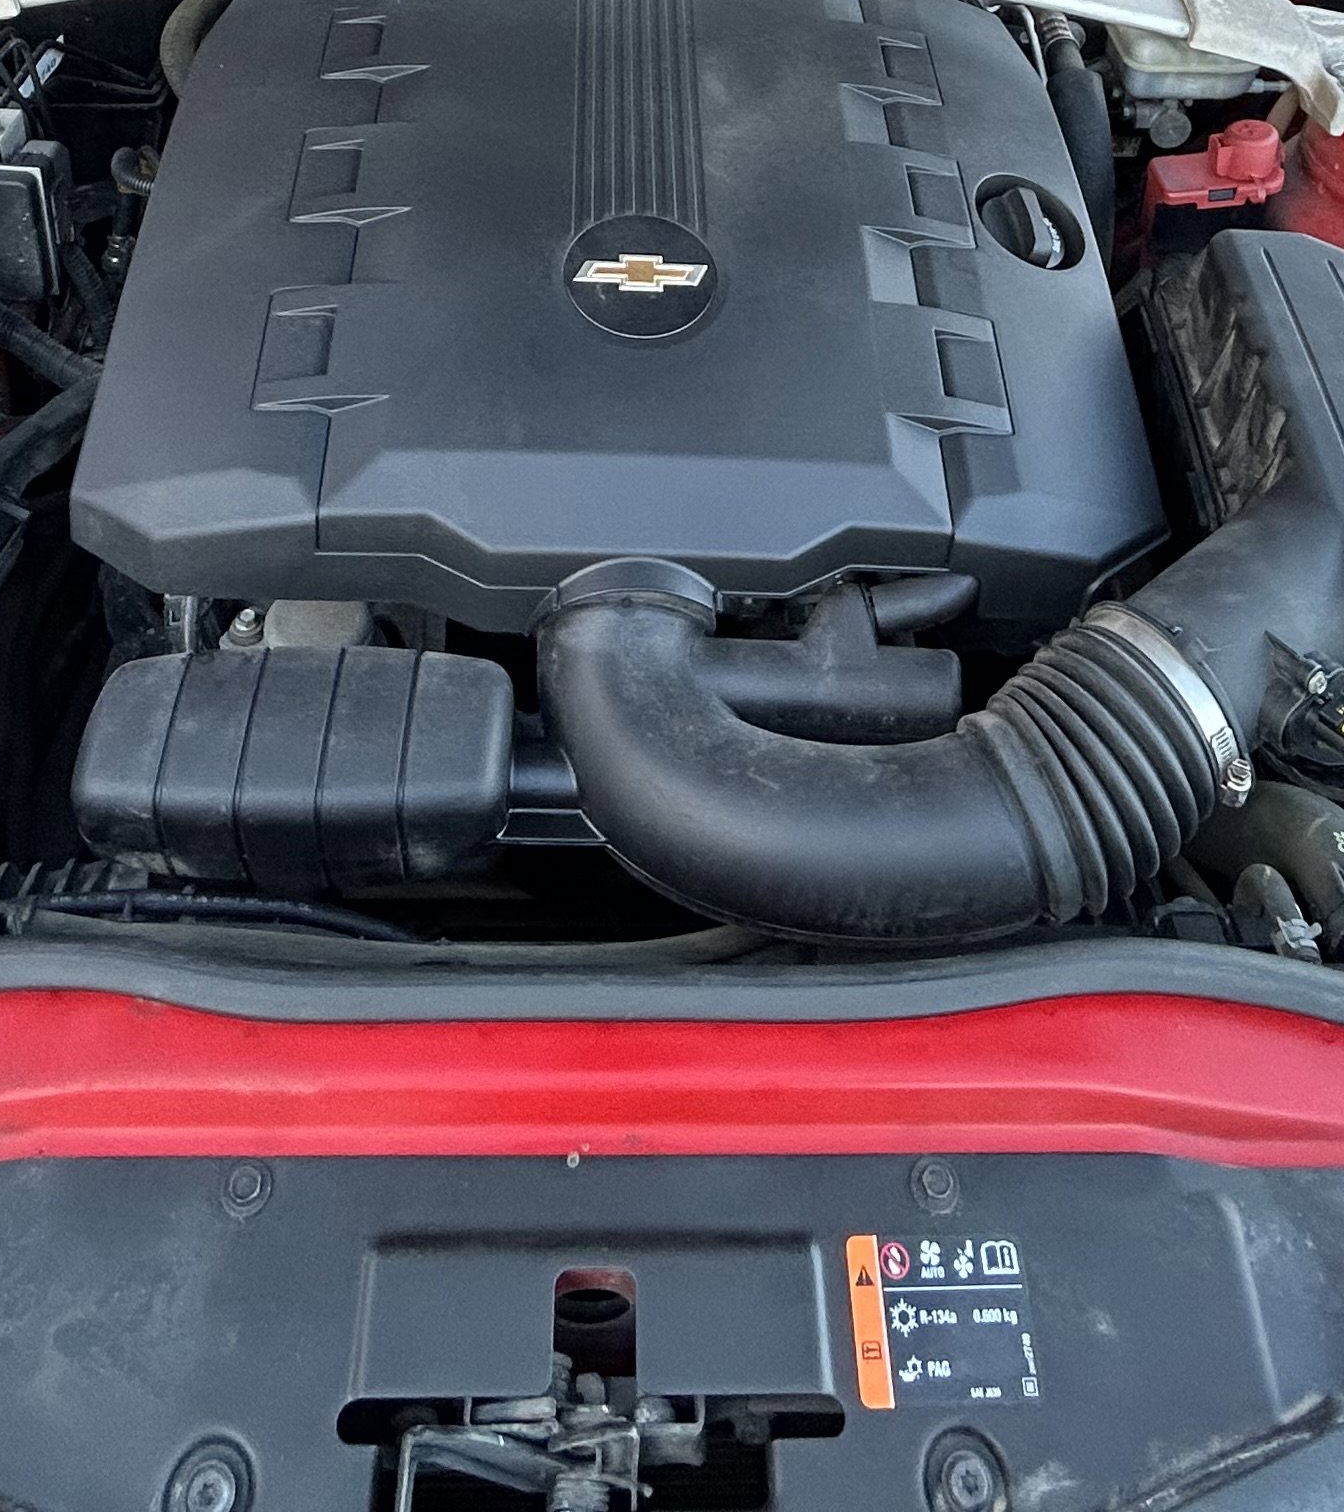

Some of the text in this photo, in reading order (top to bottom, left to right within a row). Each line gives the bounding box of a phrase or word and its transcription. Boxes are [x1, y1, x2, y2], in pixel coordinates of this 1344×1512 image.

[920, 1266, 946, 1279] AUTO
[919, 1309, 958, 1324] R-134a
[1003, 1308, 1019, 1326] kg
[927, 1360, 953, 1377] PAG
